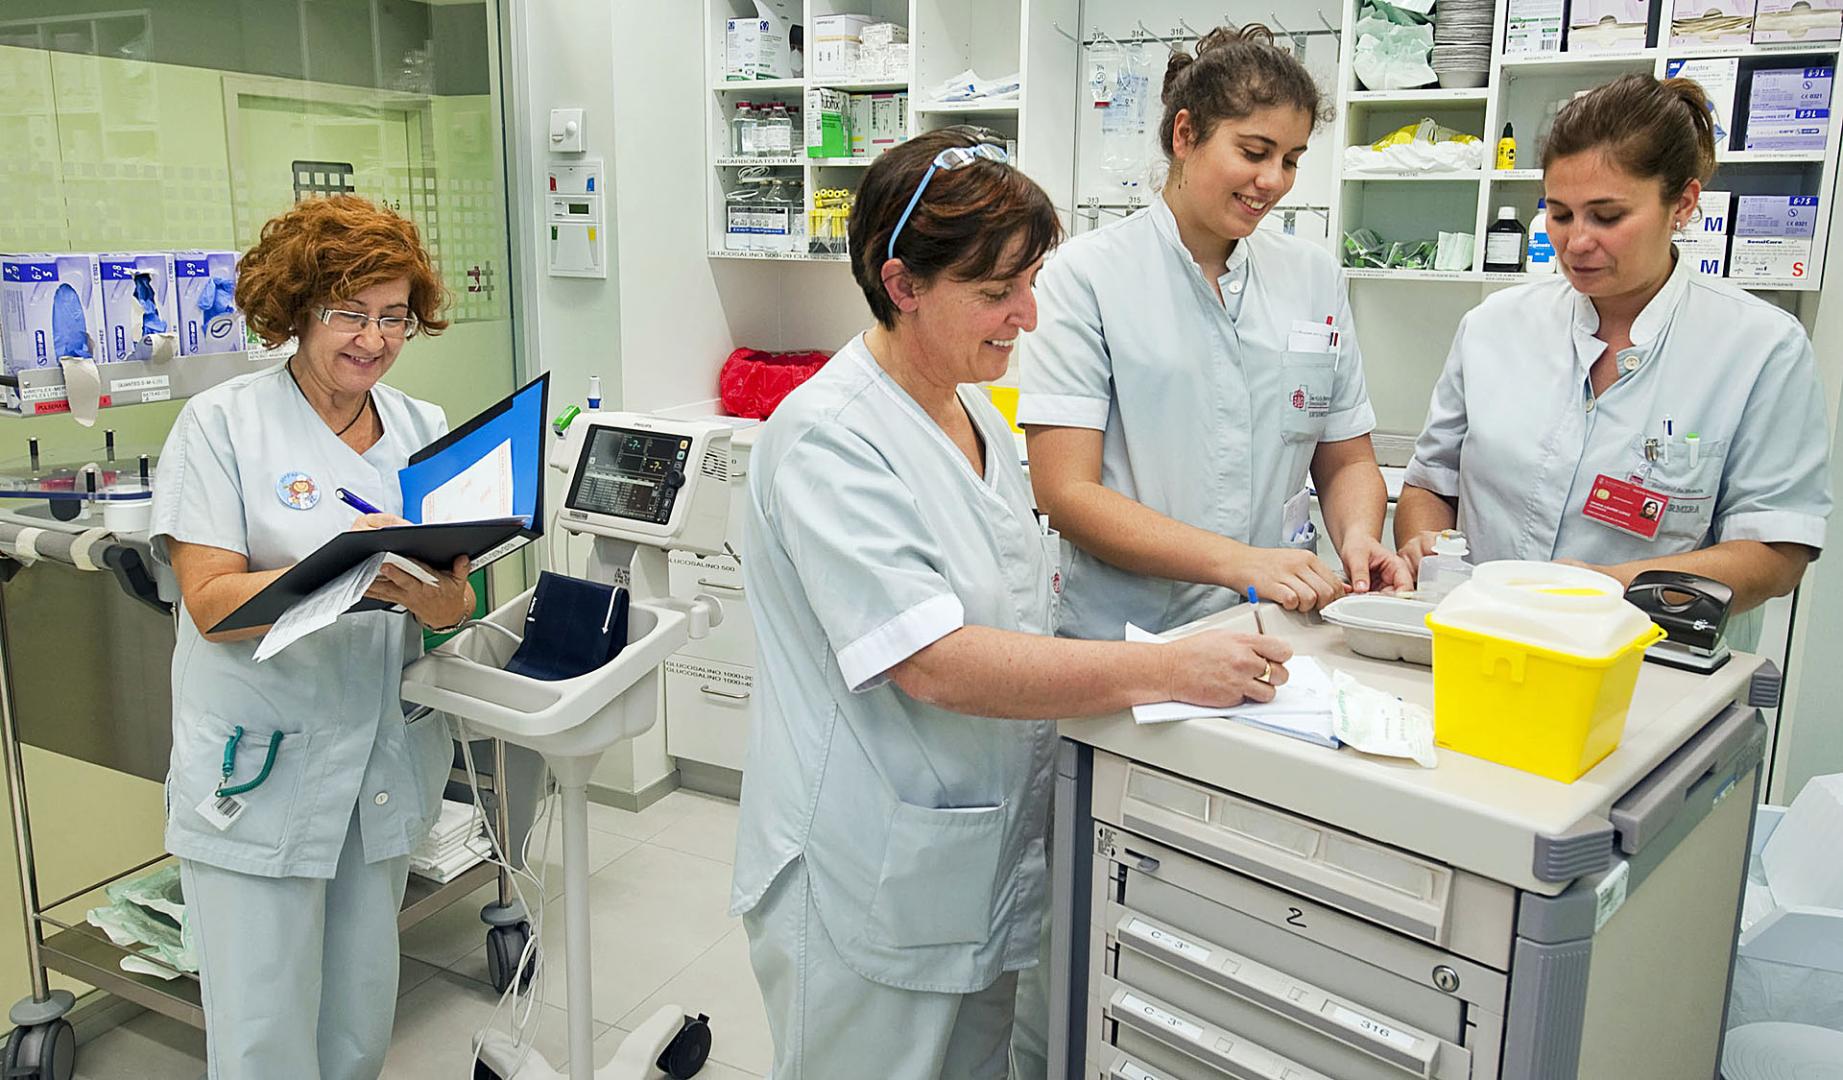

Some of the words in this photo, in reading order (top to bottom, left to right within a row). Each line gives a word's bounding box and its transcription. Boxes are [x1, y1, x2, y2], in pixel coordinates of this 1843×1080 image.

[1704, 216, 1723, 232] M
[1700, 259, 1718, 274] M
[1792, 262, 1804, 278] S
[666, 660, 722, 676] GLUCOSALINO
[666, 667, 722, 682] GLUCOSALINO
[1286, 907, 1307, 928] 2
[1360, 1020, 1390, 1038] 316
